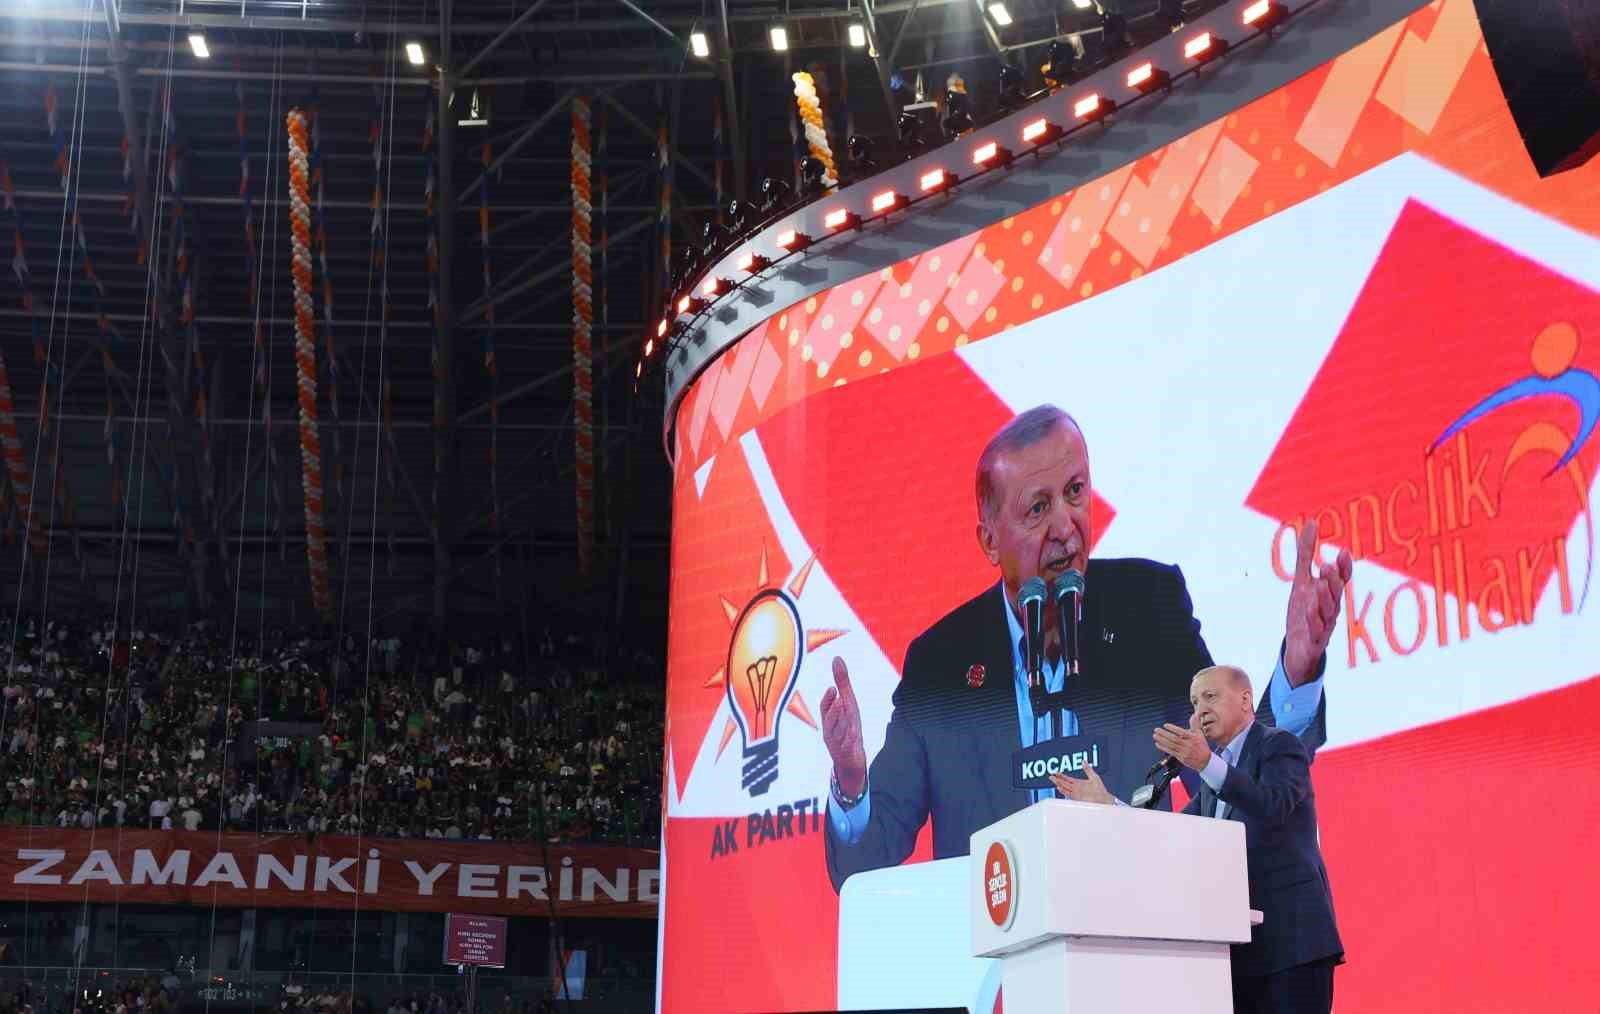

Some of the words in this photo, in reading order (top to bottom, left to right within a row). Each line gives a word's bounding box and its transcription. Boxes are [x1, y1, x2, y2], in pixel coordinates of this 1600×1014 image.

[1344, 535, 1574, 668] kolları
[710, 818, 738, 860] AK
[747, 796, 819, 848] PARTİ
[14, 848, 381, 894] ZAMANKİ
